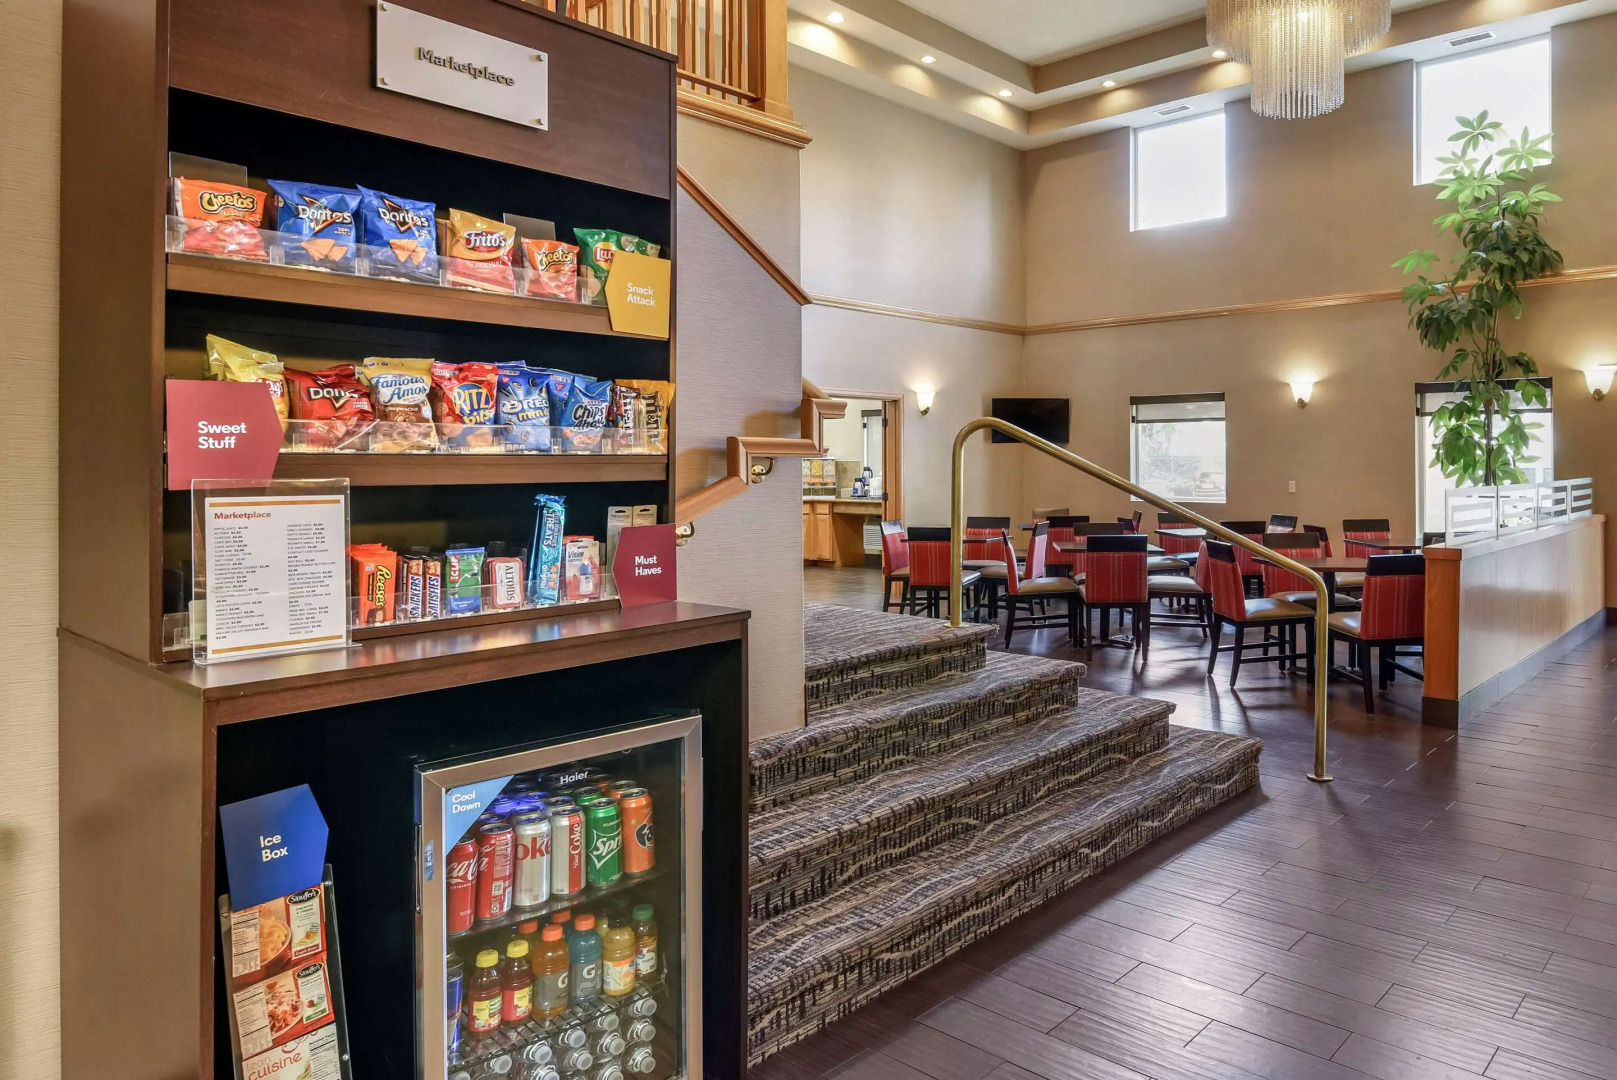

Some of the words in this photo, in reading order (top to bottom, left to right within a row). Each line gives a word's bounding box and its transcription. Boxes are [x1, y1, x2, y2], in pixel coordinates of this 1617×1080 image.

[417, 46, 515, 87] Marketplace
[202, 192, 255, 211] Cheetos
[298, 205, 352, 224] Doritos
[379, 207, 428, 227] Doritos
[464, 231, 506, 249] Fritos
[627, 282, 654, 296] Snack
[626, 294, 656, 306] Attack
[370, 376, 424, 388] Famous
[383, 386, 428, 404] Amos
[453, 388, 492, 414] RITZ
[502, 398, 549, 414] OREO
[574, 403, 605, 420] Chips
[198, 420, 247, 434] Sweet
[198, 436, 236, 448] Stuff
[214, 511, 272, 520] Marketplace
[544, 512, 555, 546] TREATS
[451, 556, 460, 576] CLIF
[634, 555, 658, 566] Must
[634, 566, 662, 576] Haves
[504, 564, 516, 600] ALTOIDS
[410, 575, 422, 618] SNICKERS
[428, 576, 440, 618] SATISFIES
[560, 771, 588, 784] Haier
[452, 790, 476, 803] Cool
[452, 802, 481, 814] Down
[260, 834, 282, 848] Ice
[570, 823, 582, 854] Coke
[262, 846, 288, 862] Box
[516, 836, 551, 861] oke
[290, 890, 317, 903] Stouffer's
[248, 1052, 303, 1080] cuisine
